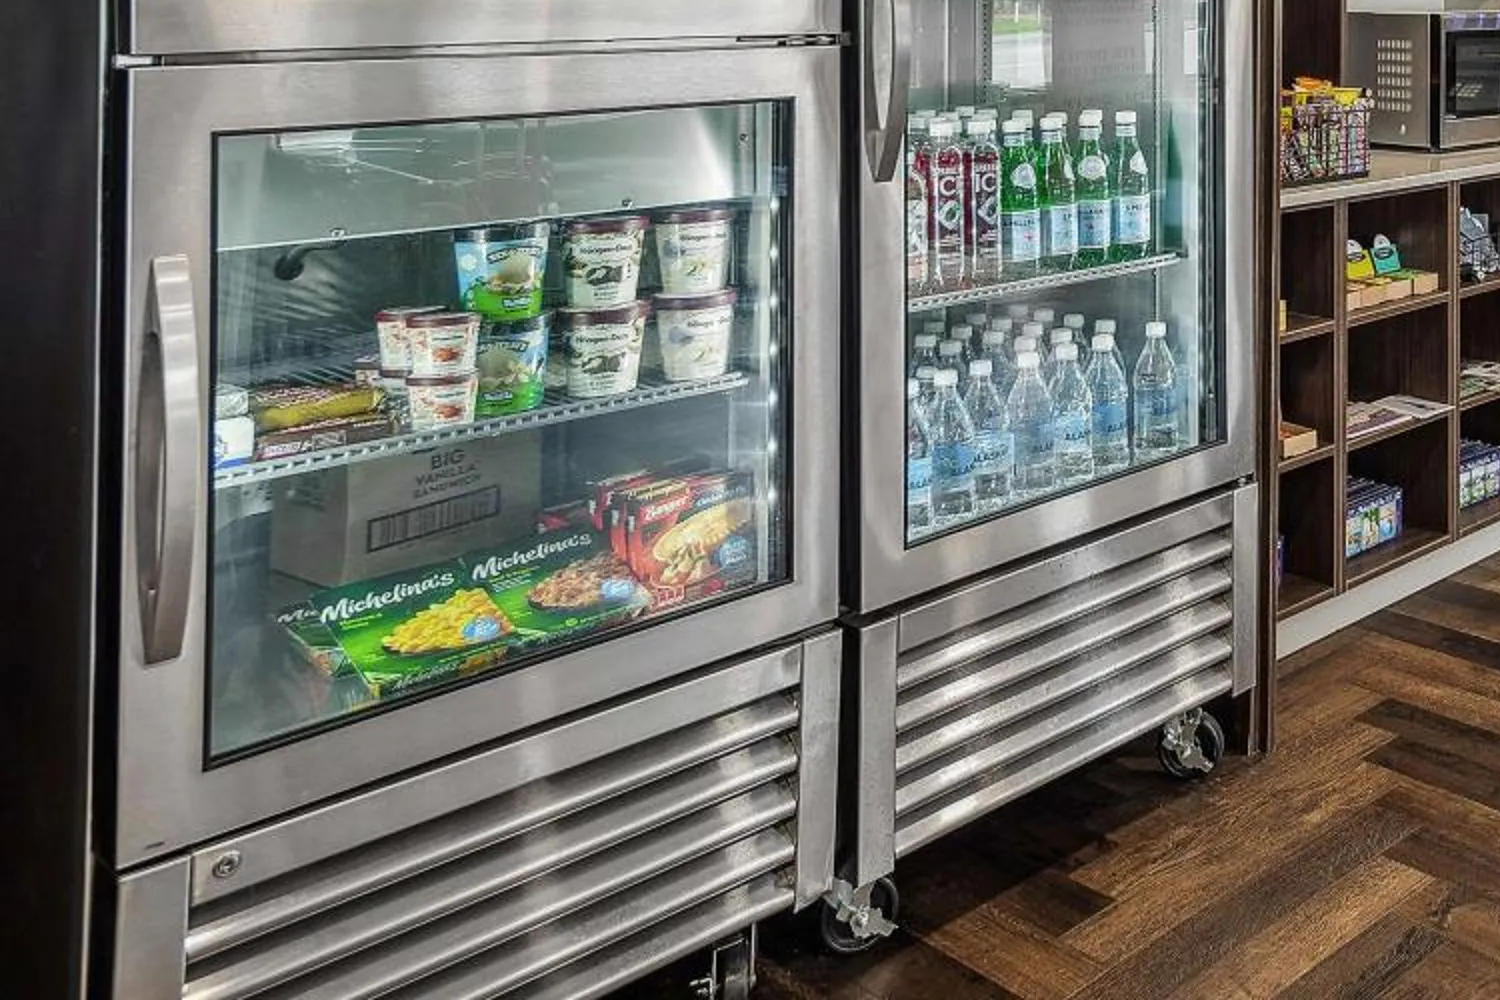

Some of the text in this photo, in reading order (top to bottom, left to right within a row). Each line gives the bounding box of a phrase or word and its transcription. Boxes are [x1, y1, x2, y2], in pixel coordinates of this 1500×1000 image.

[431, 449, 465, 470] BIG
[471, 532, 593, 581] Michelina's
[320, 571, 455, 624] Michelina's
